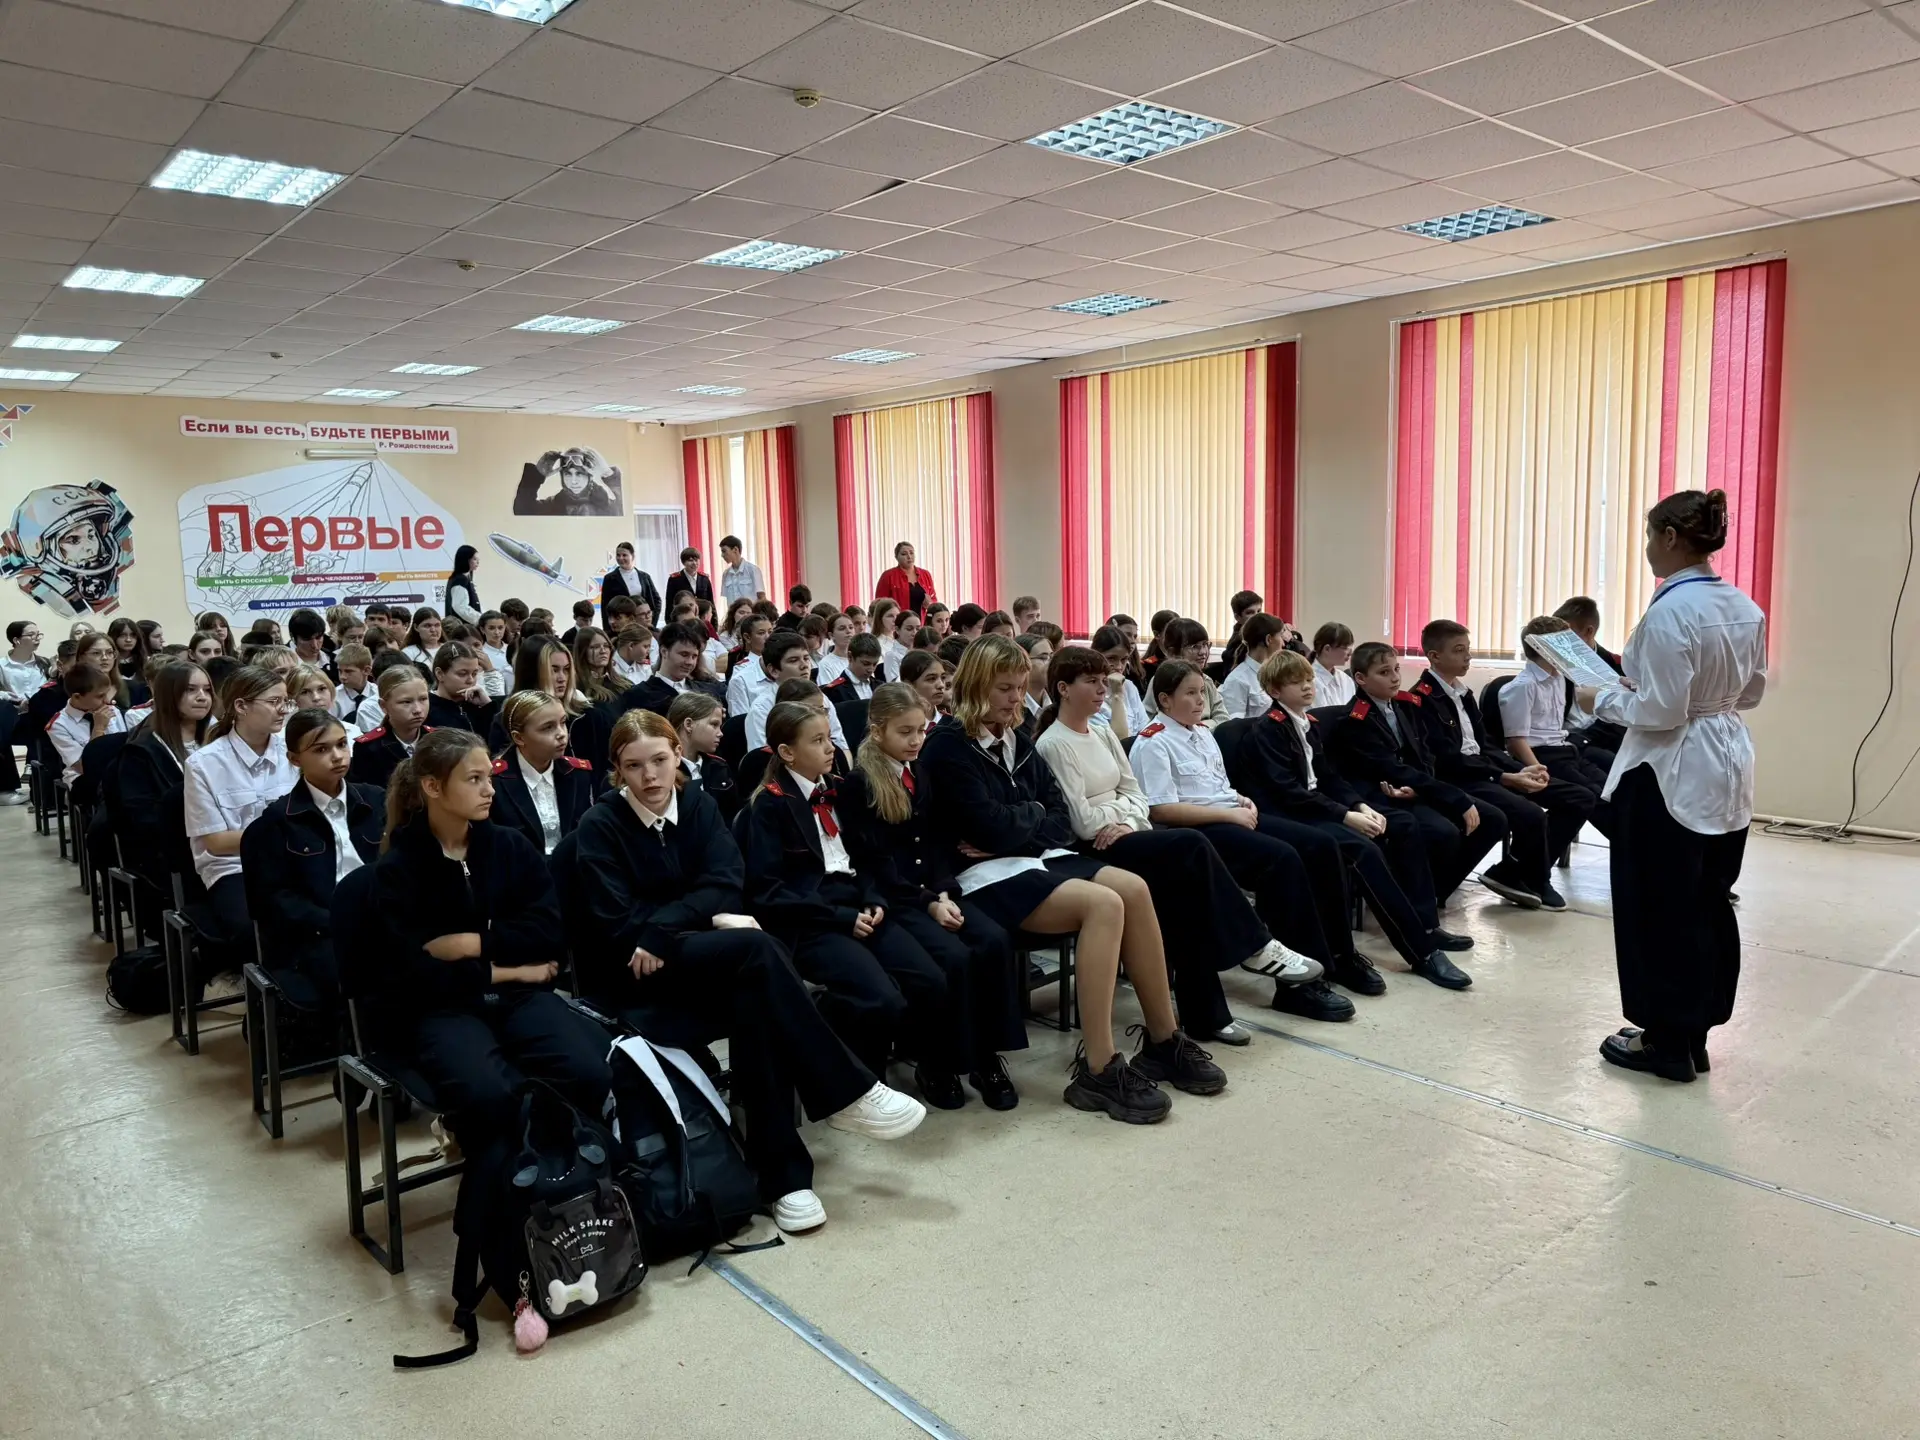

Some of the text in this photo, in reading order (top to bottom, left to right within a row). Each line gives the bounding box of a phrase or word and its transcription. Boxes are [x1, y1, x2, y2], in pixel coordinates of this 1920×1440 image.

[185, 419, 450, 442] Если вы есть, БУДЬТЕ ПЕРВЫМИ
[388, 442, 455, 451] Рождественский
[207, 504, 445, 567] Первые
[551, 1219, 614, 1247] MILK SHAKE
